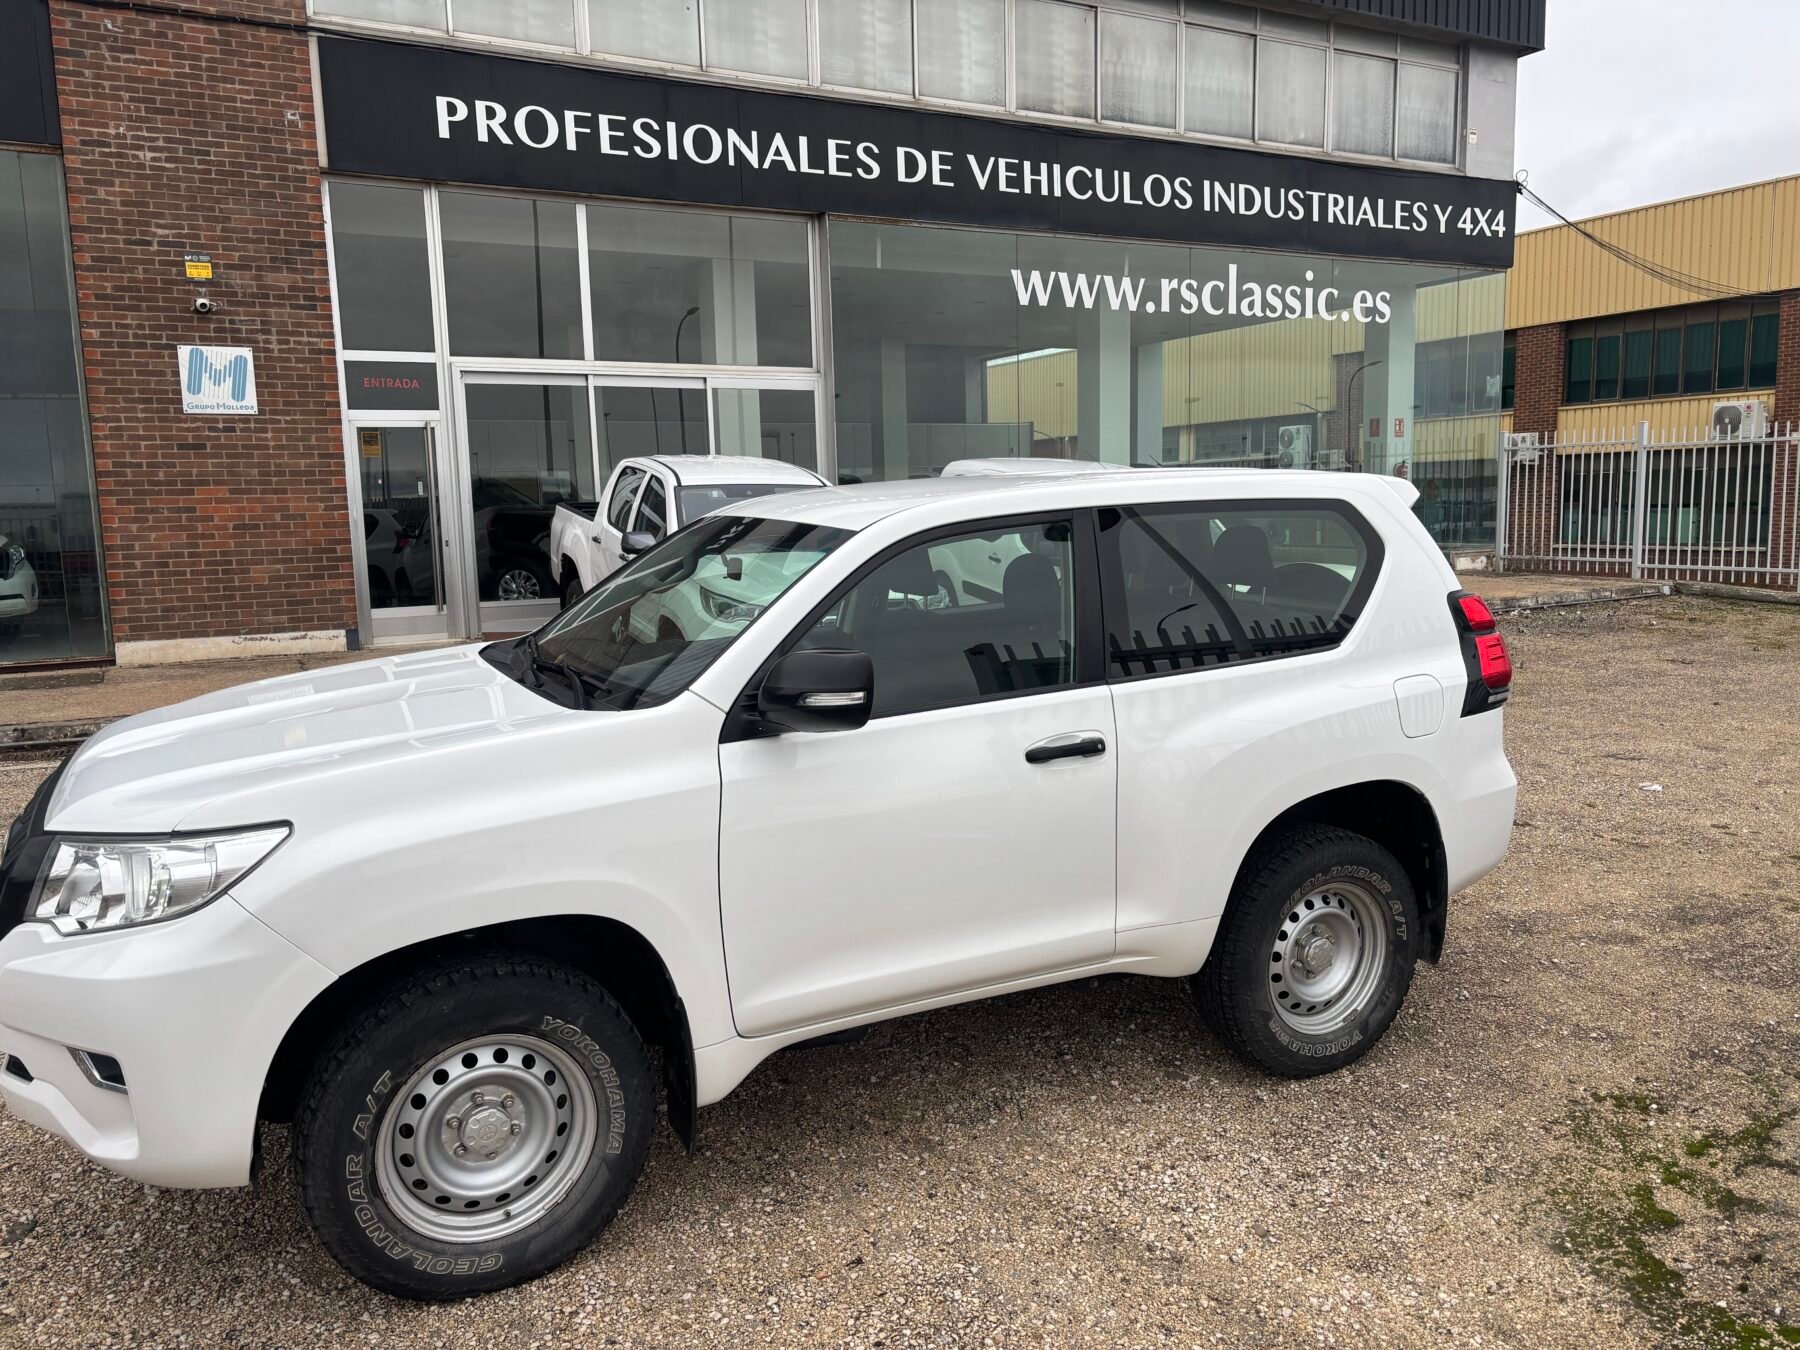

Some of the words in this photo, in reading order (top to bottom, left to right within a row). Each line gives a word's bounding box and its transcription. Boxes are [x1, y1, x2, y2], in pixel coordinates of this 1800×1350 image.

[435, 95, 881, 180] PROFESIONALES
[896, 146, 955, 187] DE
[966, 153, 1193, 210] VEHICULOS
[1203, 179, 1428, 232] INDUSTRIALES
[1433, 203, 1453, 234] Y
[1457, 206, 1506, 238] 4X4
[1010, 263, 1391, 324] www.rsclassic.es
[363, 377, 420, 389] ENTRADA
[1389, 900, 1407, 940] A/T
[1268, 1017, 1364, 1057] YOKOHAMA
[353, 1070, 392, 1140] A/T
[541, 1015, 626, 1155] YOKOHAMA
[346, 1154, 504, 1275] GEOLANDAR
